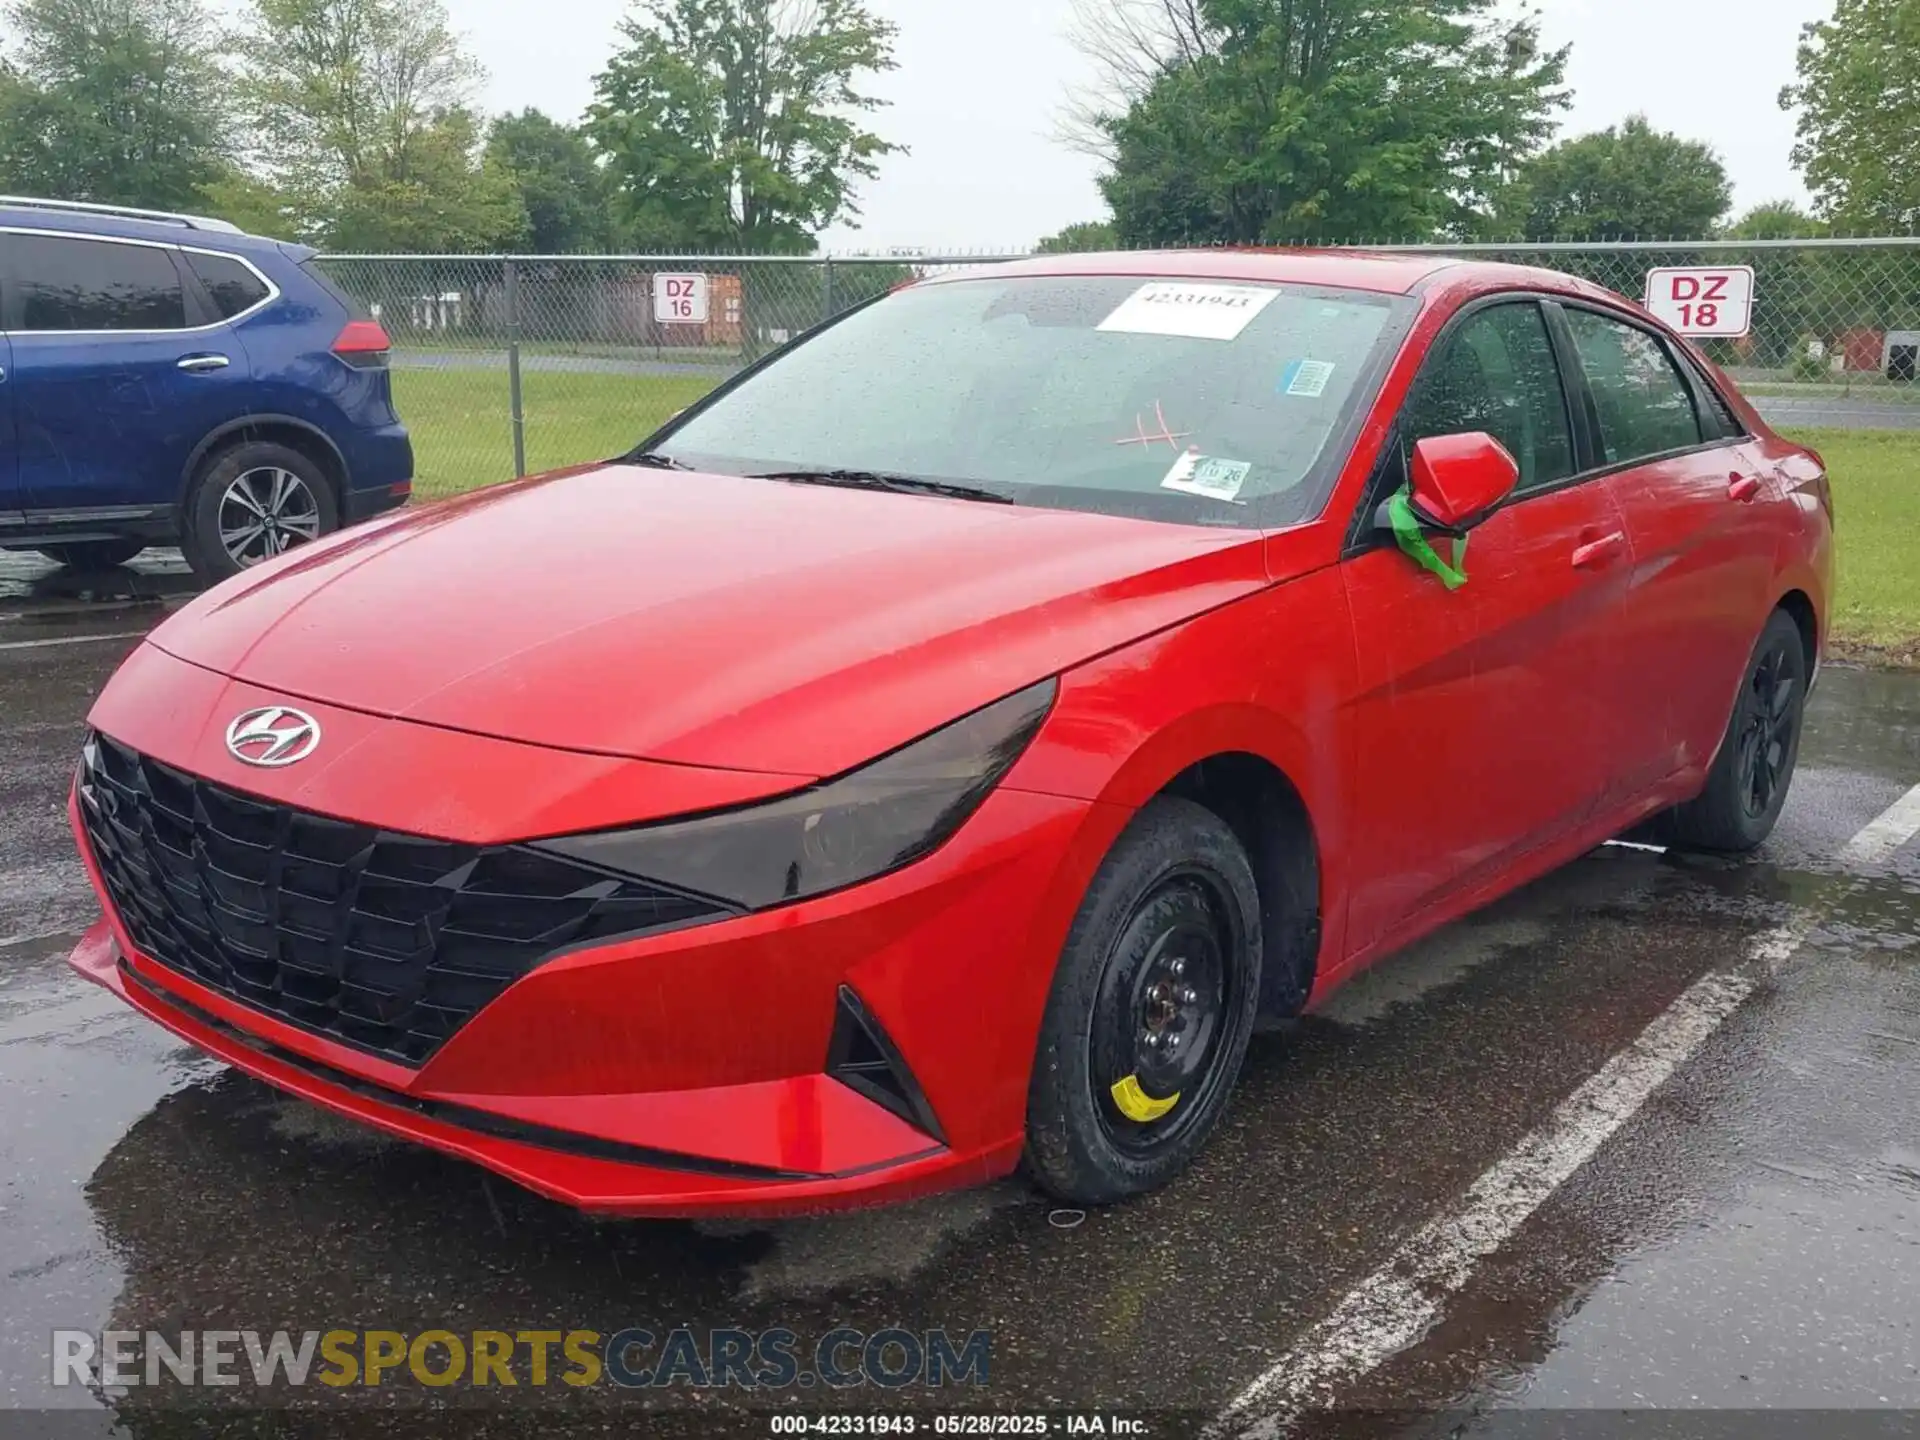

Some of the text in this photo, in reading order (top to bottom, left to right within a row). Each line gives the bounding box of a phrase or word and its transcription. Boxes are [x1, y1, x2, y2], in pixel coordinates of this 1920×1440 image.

[667, 279, 695, 297] DZ
[1672, 276, 1729, 301] DZ
[671, 299, 692, 317] 16
[1677, 303, 1718, 327] 18
